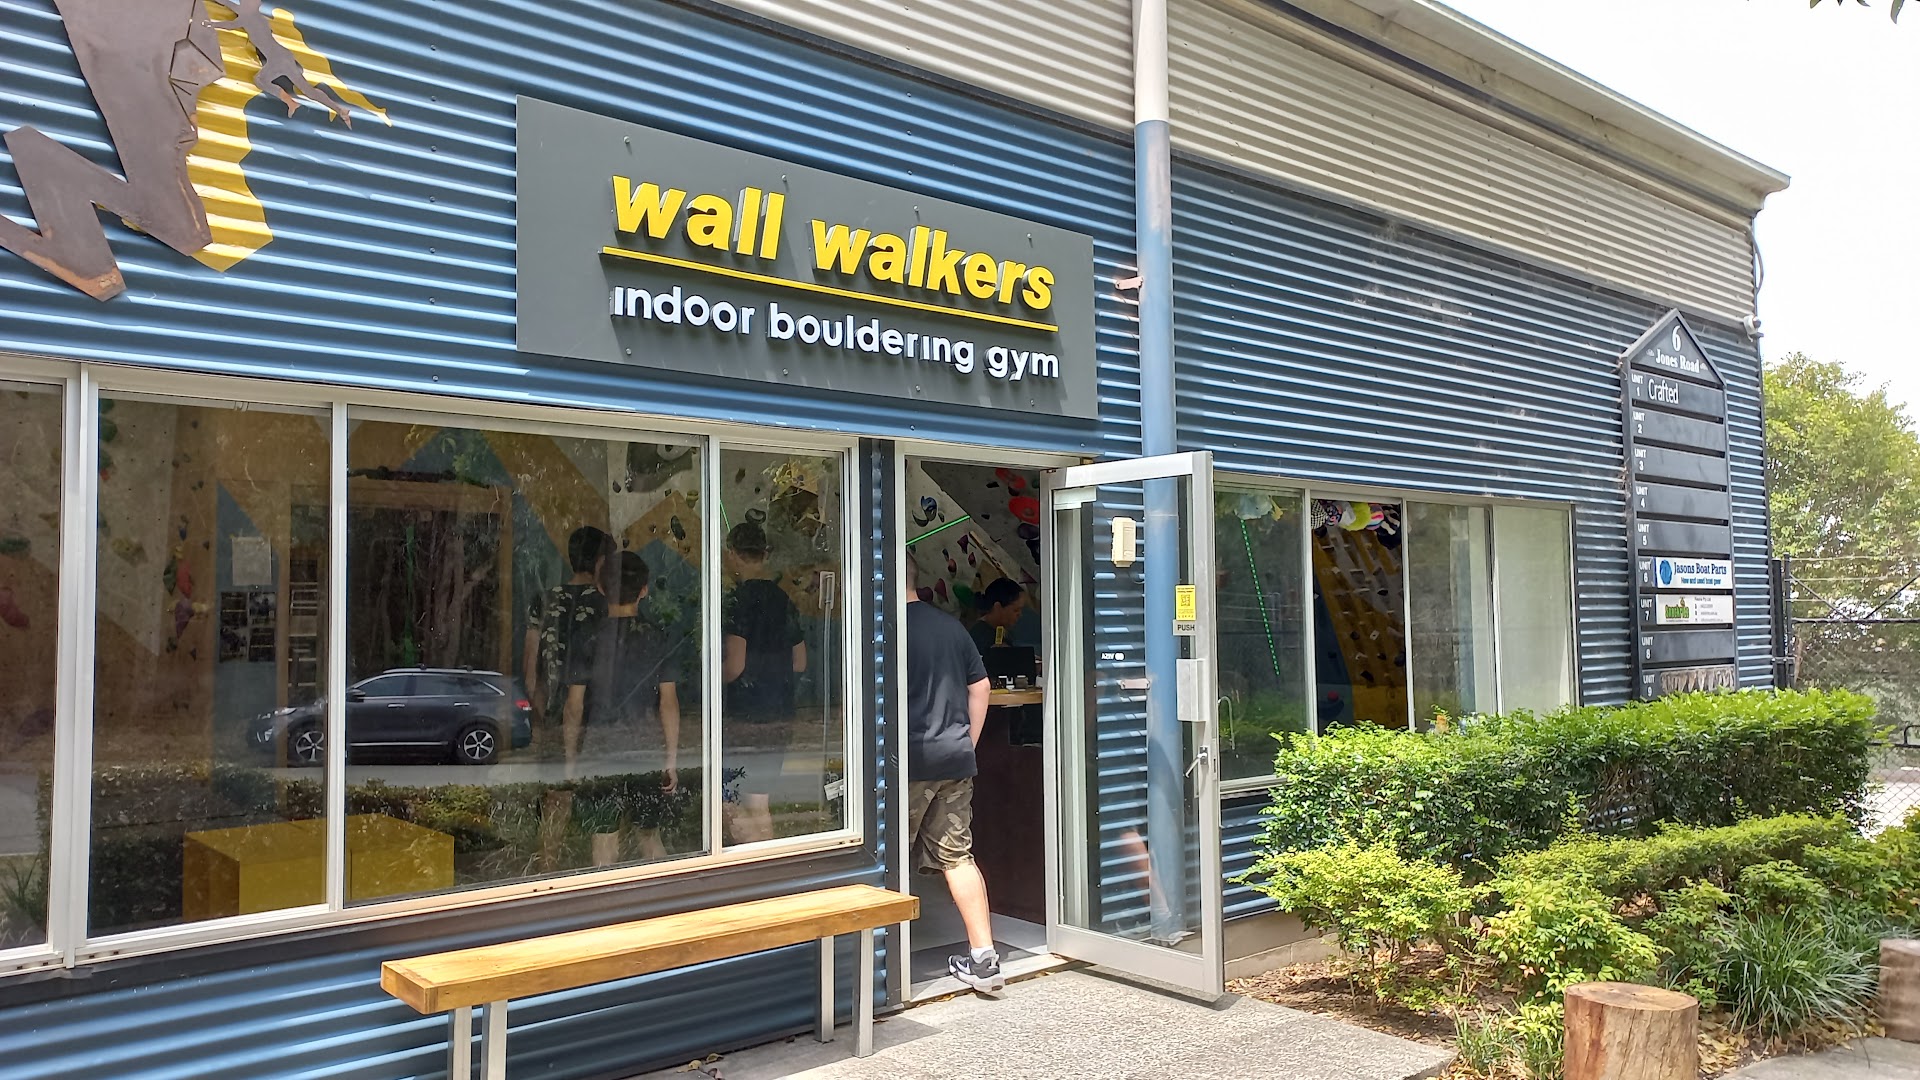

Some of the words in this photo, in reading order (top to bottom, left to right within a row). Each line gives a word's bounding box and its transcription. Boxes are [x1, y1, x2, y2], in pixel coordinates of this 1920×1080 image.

[611, 175, 785, 261] wall
[810, 219, 1055, 310] walkers
[611, 285, 755, 335] indoor
[768, 302, 974, 374] bouldering
[986, 345, 1060, 381] gym
[1672, 325, 1681, 352] 6
[1656, 349, 1678, 368] Jones
[1679, 355, 1700, 373] Road
[1631, 373, 1643, 384] UNIT
[1636, 387, 1640, 396] 1
[1648, 378, 1679, 404] Crafted
[1633, 411, 1645, 422] UNIT
[1637, 424, 1643, 434] 2
[1634, 448, 1646, 458] UNIT
[1639, 460, 1644, 471] 3
[1636, 486, 1648, 496] UNIT
[1640, 498, 1646, 508] 4
[1638, 523, 1649, 533] UNIT
[1643, 535, 1647, 546] 5
[1639, 560, 1651, 571] UNIT
[1673, 561, 1695, 575] Jasons
[1696, 562, 1711, 574] Boat
[1711, 563, 1727, 575] Parts
[1643, 572, 1648, 583] 6
[1641, 598, 1652, 608] UNIT
[1645, 611, 1650, 621] 7
[1642, 636, 1653, 646] UNIT
[1646, 649, 1651, 659] 8
[1643, 674, 1655, 684] UNIT
[1647, 686, 1652, 697] 9
